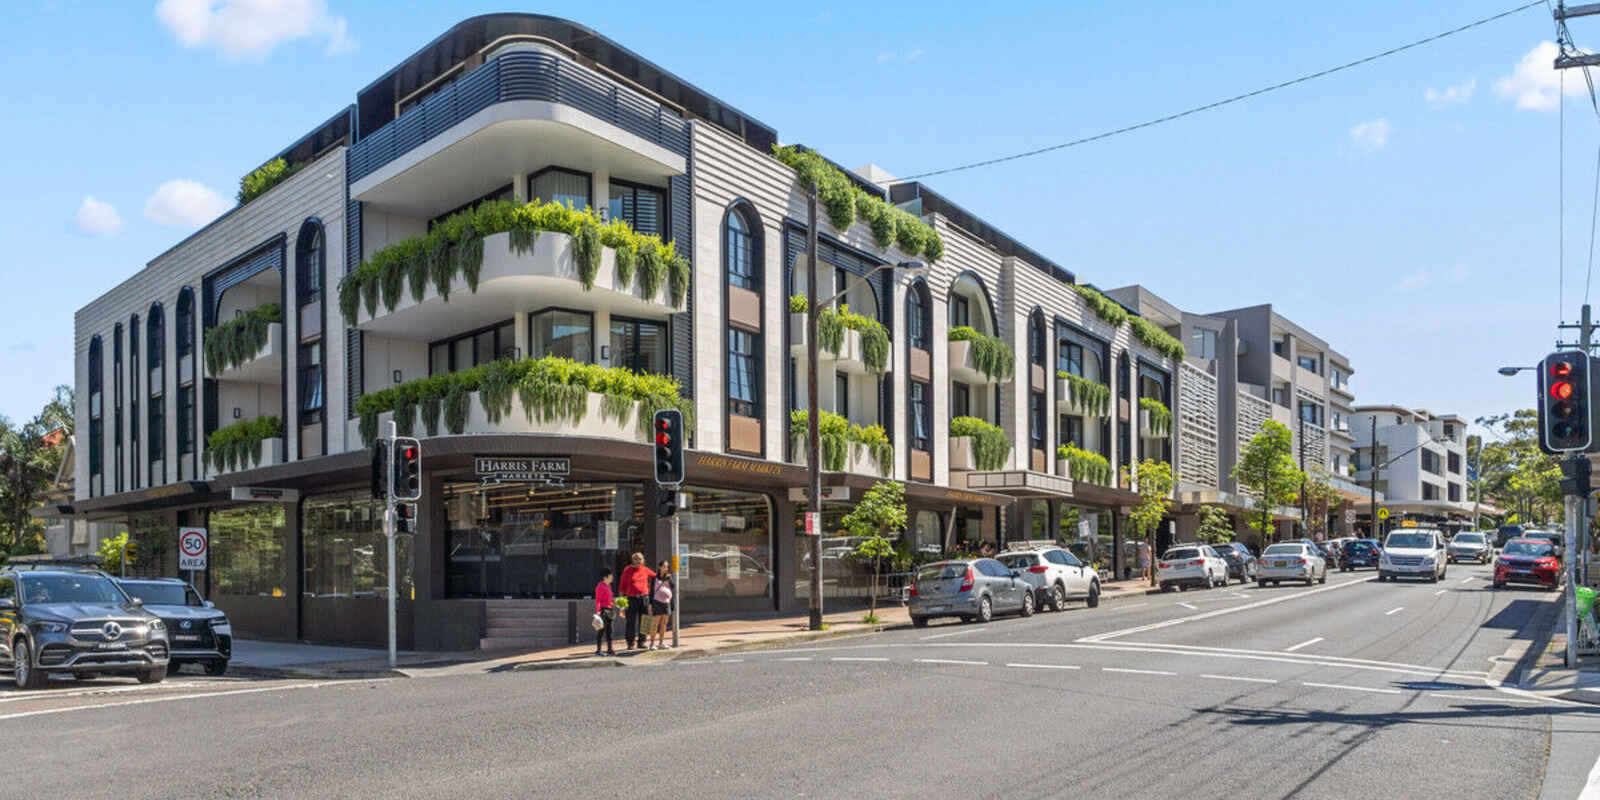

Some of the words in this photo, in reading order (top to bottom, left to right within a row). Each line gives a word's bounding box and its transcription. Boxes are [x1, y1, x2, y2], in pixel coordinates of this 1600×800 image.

[480, 460, 528, 472] HARRIS
[531, 460, 566, 472] FARM
[185, 538, 202, 550] 50
[181, 558, 206, 567] AREA
